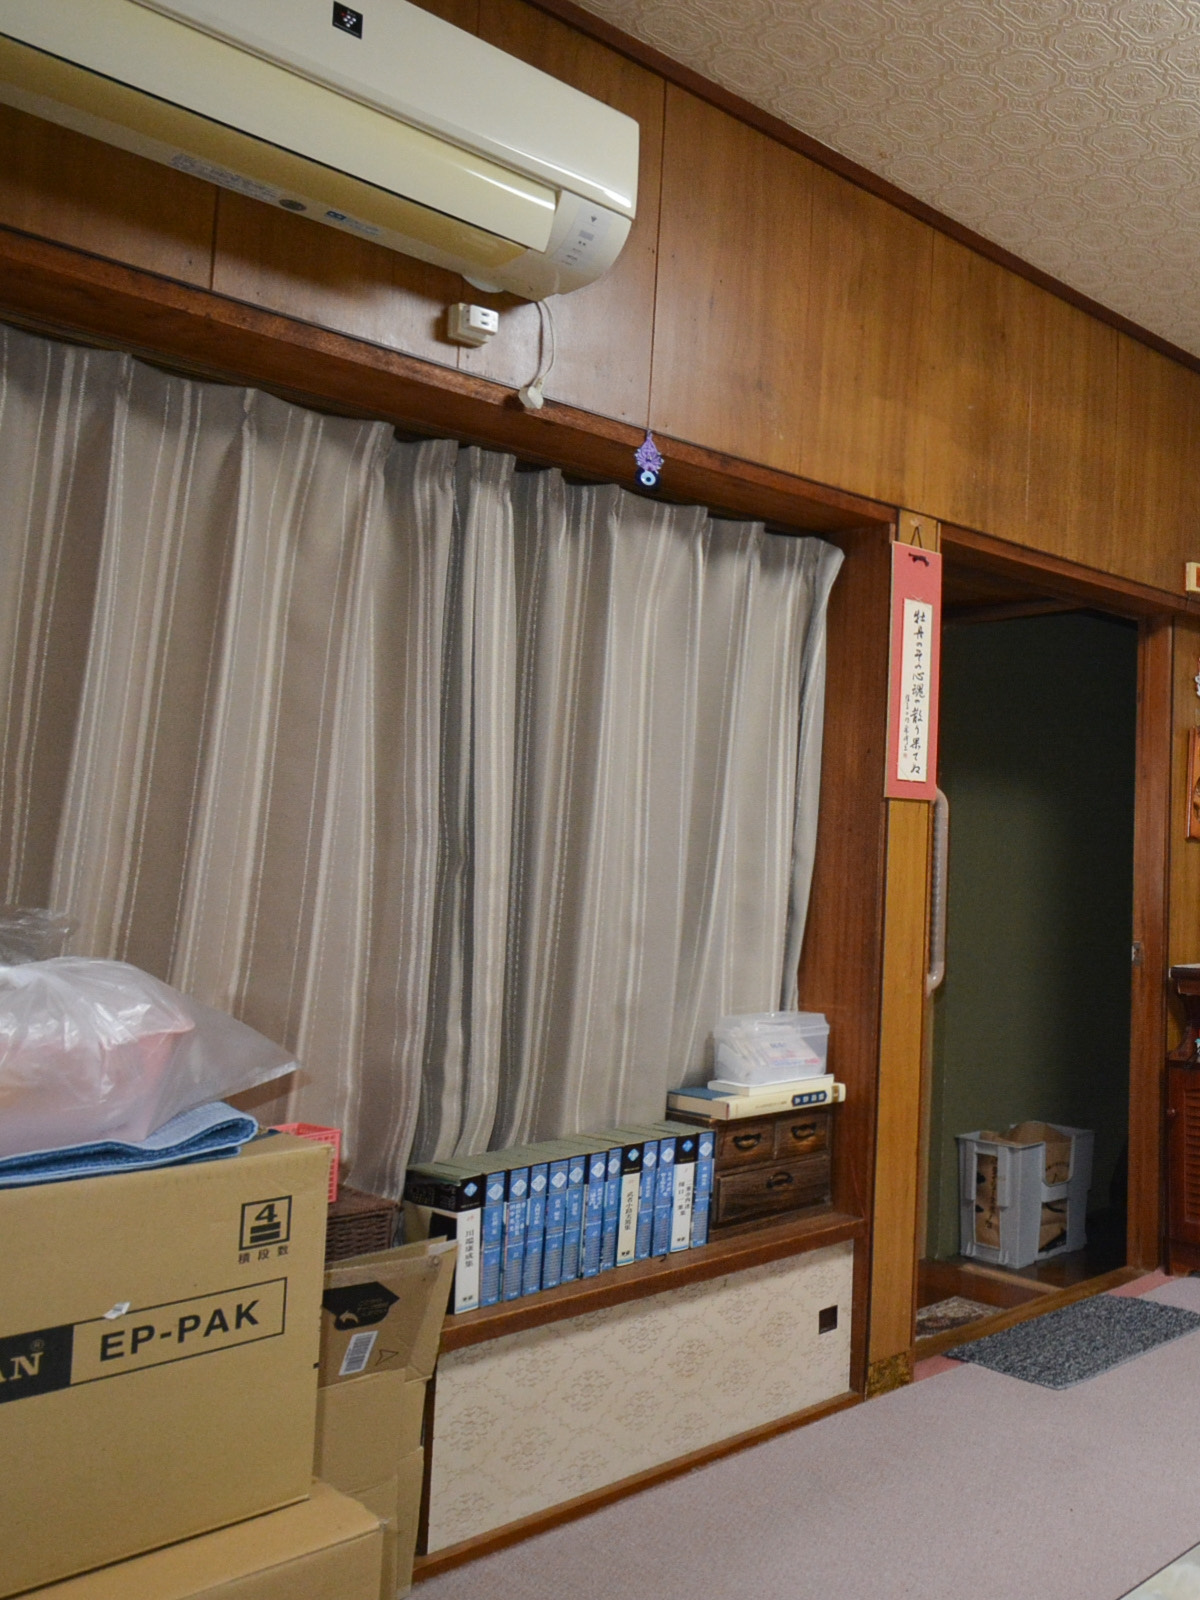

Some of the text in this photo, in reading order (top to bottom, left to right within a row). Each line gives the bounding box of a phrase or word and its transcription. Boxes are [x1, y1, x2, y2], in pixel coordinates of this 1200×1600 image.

[255, 1203, 278, 1223] 4
[238, 1245, 289, 1264] 積段数
[99, 1299, 260, 1362] EP-PAK
[0, 1351, 44, 1384] N
